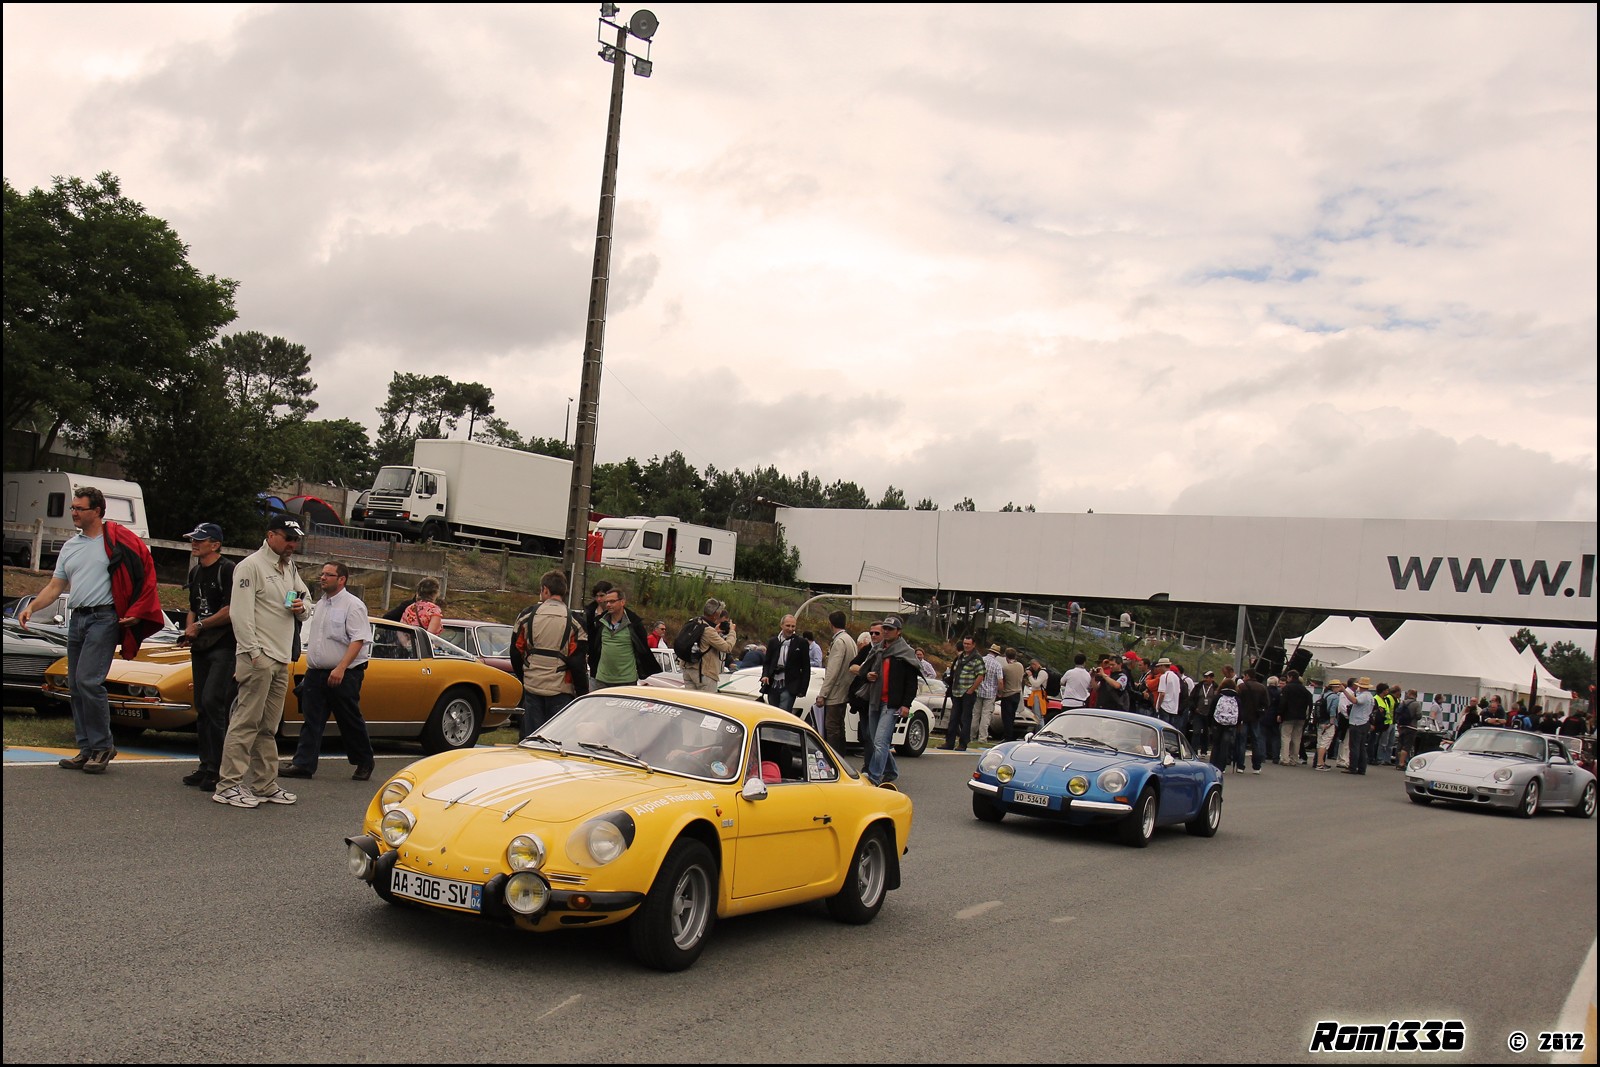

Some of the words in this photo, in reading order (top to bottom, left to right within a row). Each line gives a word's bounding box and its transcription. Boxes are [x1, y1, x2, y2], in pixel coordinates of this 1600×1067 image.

[240, 579, 250, 588] 20
[1387, 554, 1597, 598] www.l
[633, 799, 669, 816] Alpine
[665, 791, 704, 803] Renault
[702, 790, 716, 800] elf
[404, 851, 490, 875] ALPINE
[393, 871, 469, 905] AA-306-SV
[471, 897, 480, 908] 04
